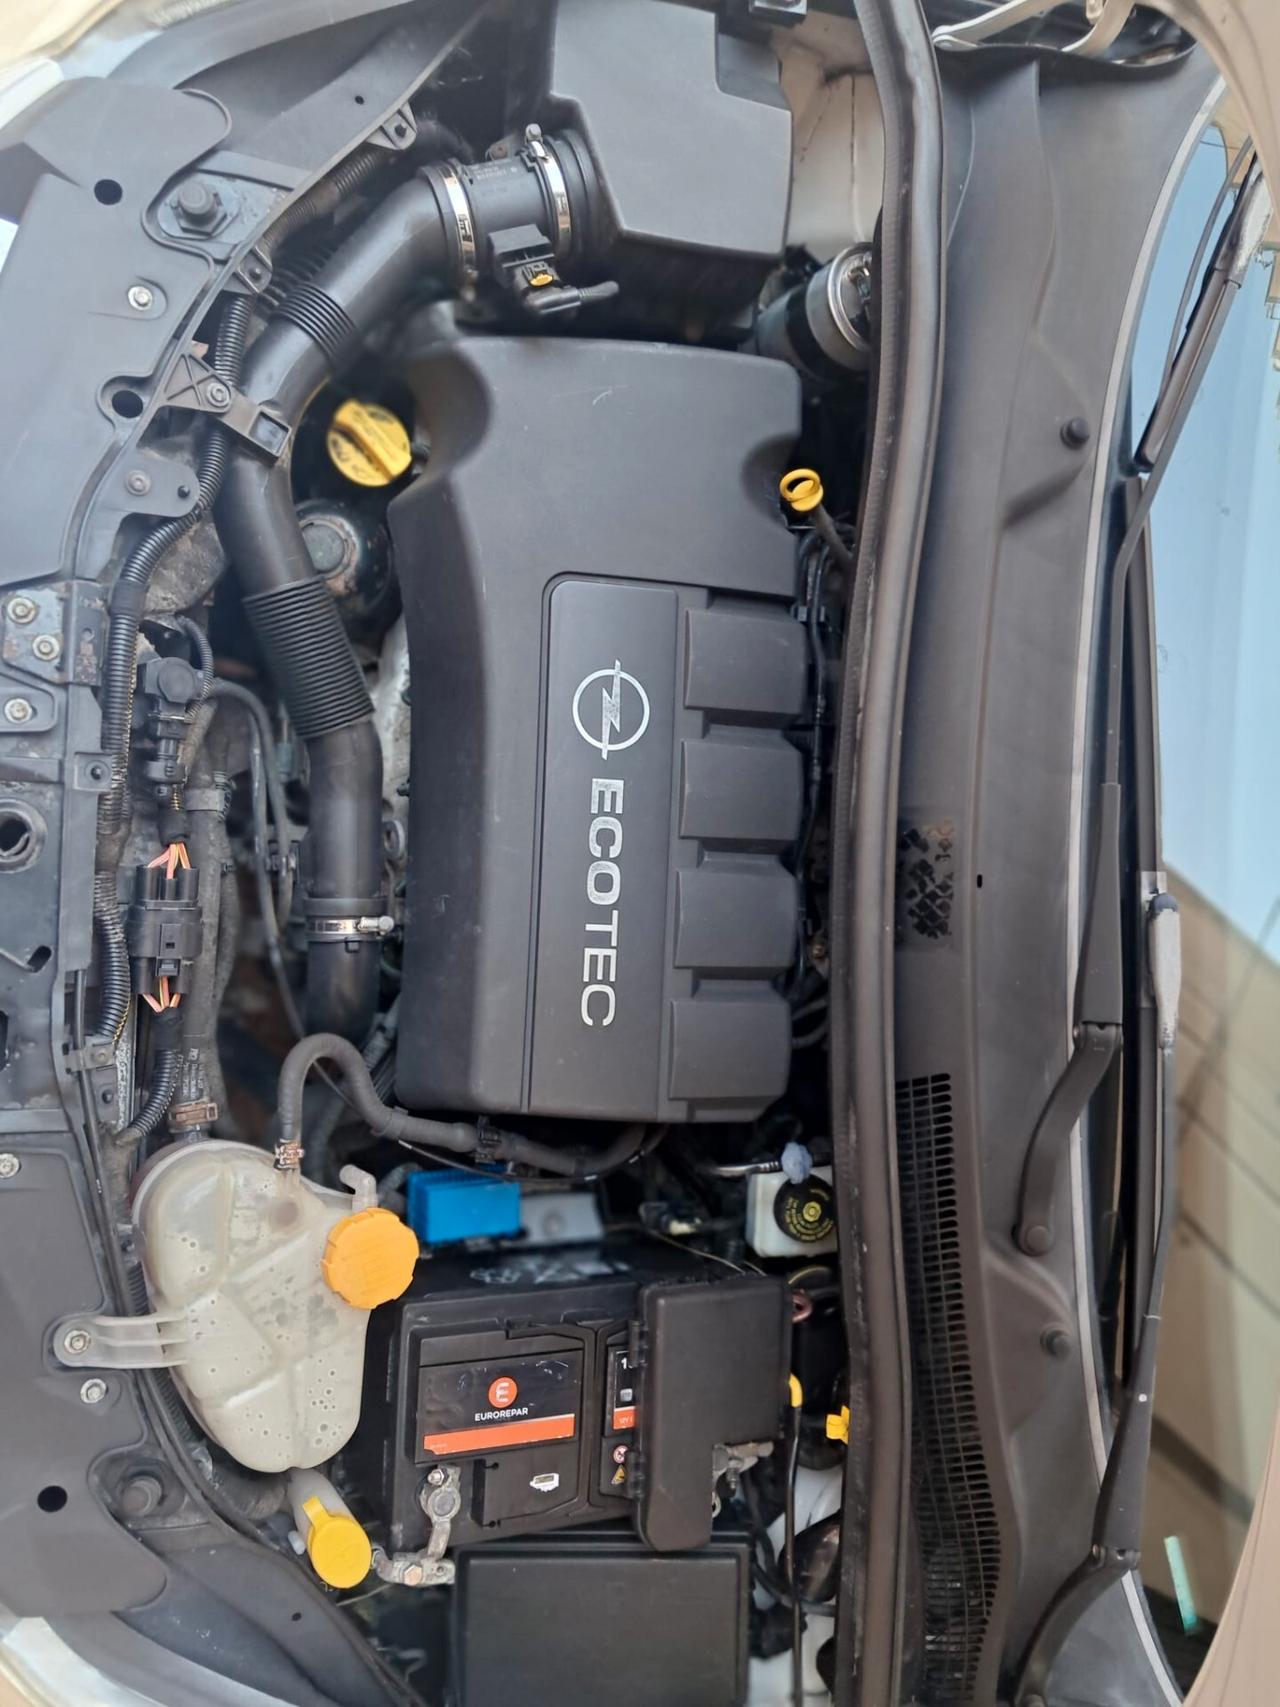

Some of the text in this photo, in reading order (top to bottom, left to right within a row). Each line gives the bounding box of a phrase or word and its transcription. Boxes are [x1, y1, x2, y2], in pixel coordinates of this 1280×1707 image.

[580, 778, 625, 1027] ECOTEC
[495, 1382, 509, 1402] E
[474, 1407, 529, 1421] EUROREPAR
